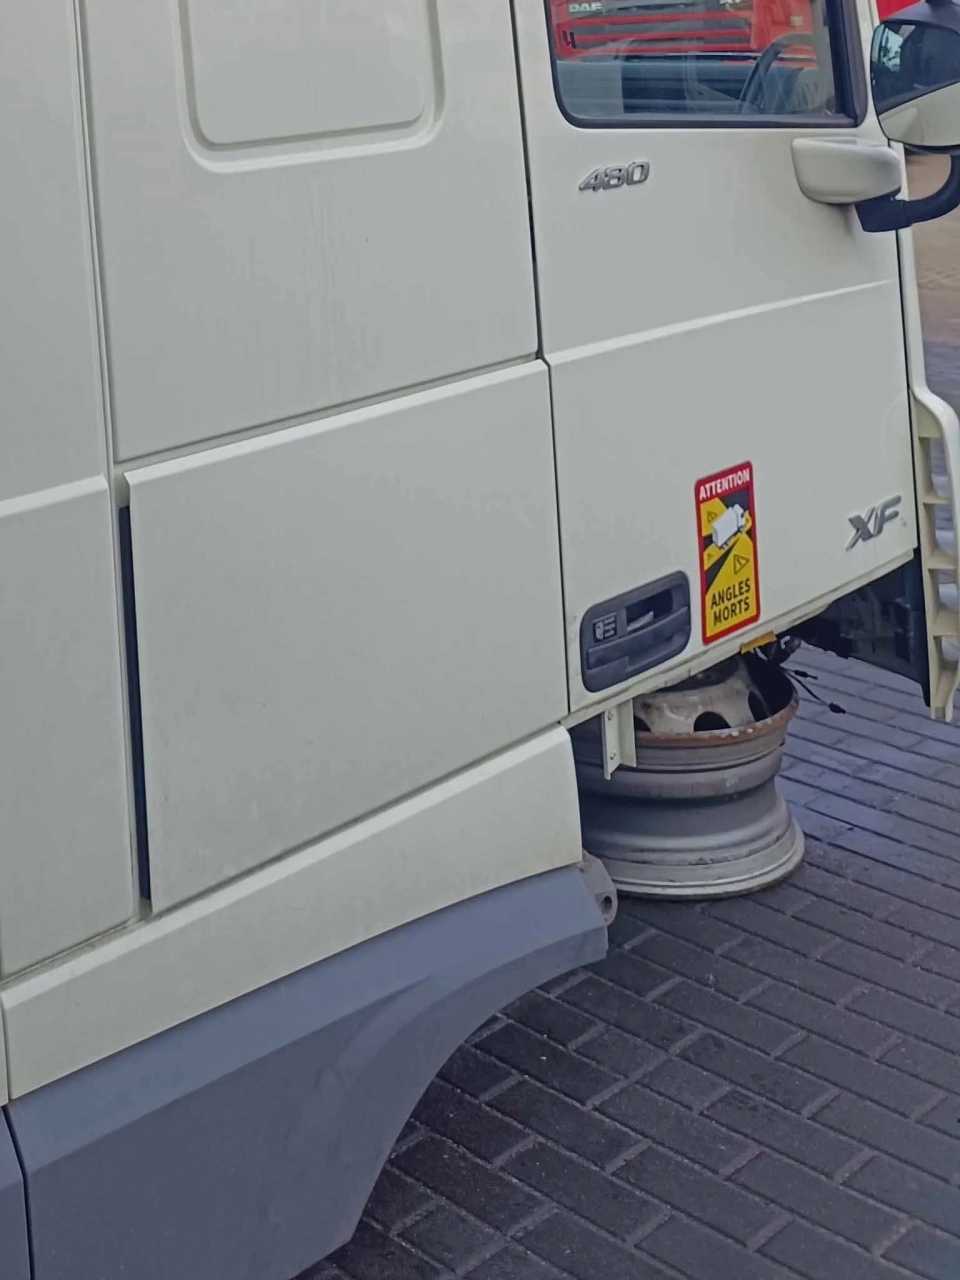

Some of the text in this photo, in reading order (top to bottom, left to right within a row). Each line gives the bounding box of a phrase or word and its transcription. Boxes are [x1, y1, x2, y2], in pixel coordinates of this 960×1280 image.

[568, 1, 604, 13] DAF
[699, 467, 750, 501] ATTENTION
[845, 494, 902, 552] XF
[710, 577, 751, 610] ANGLES
[713, 596, 750, 627] MORTS
